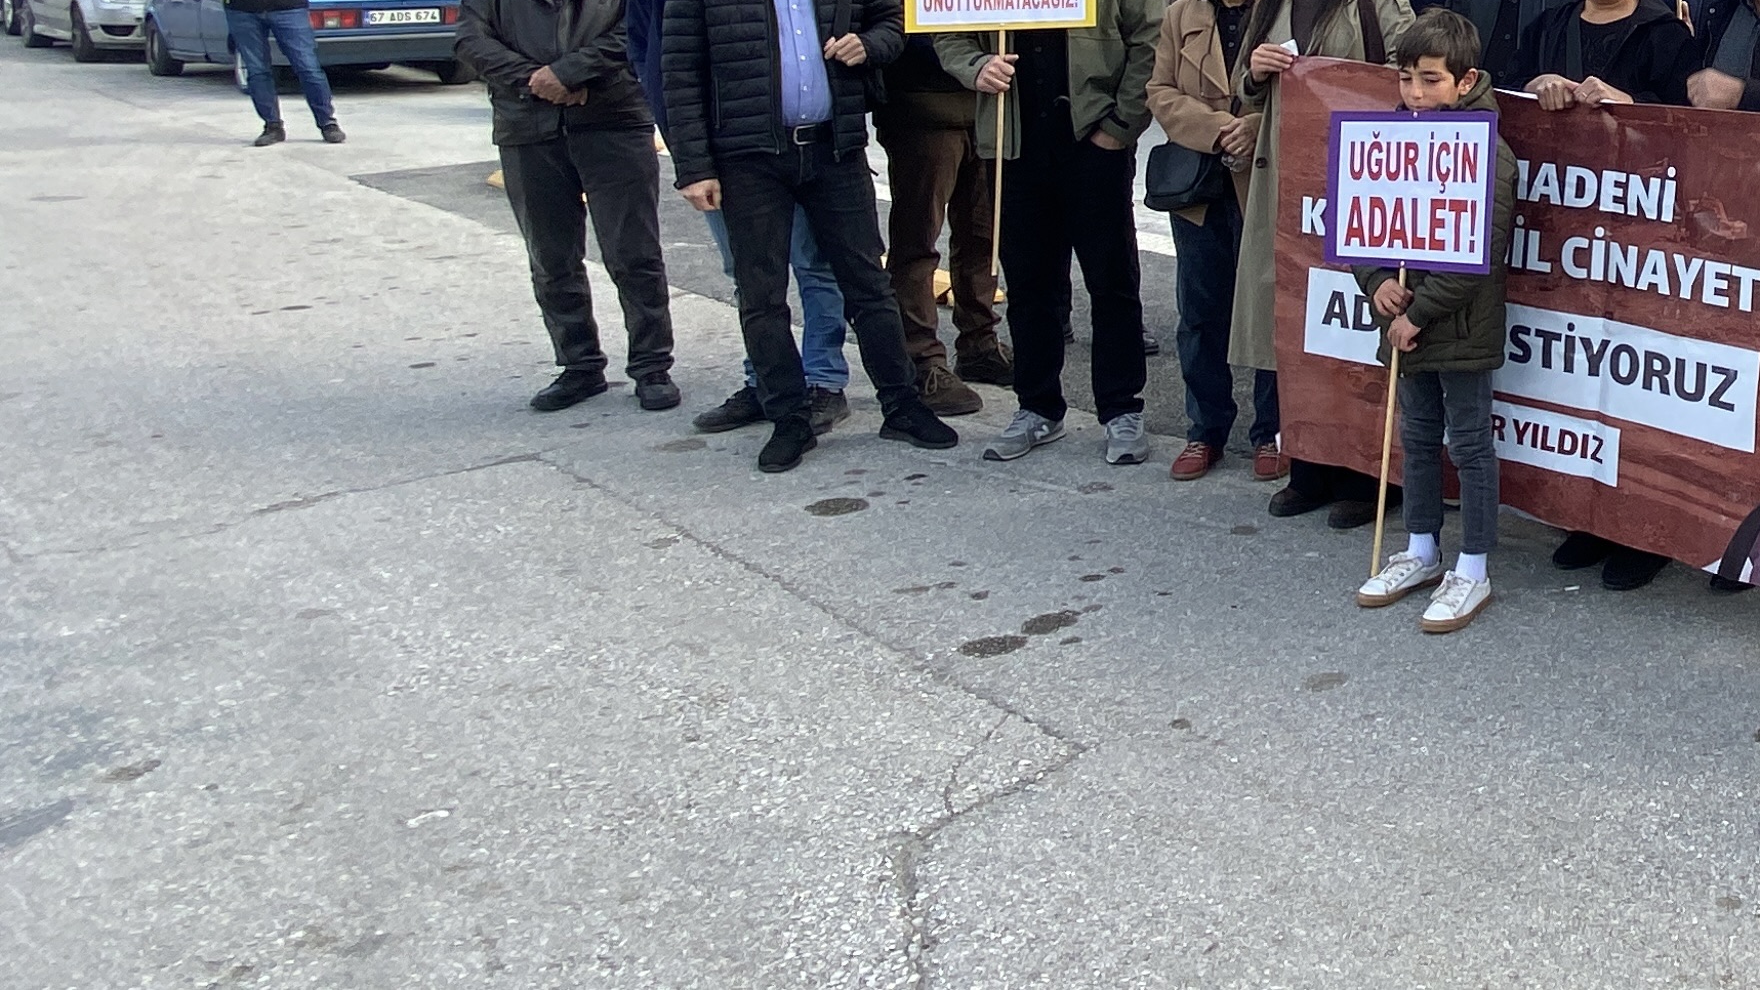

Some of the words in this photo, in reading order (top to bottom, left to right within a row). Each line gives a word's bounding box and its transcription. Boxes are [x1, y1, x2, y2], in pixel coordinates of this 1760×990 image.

[370, 13, 384, 22] 67
[390, 12, 411, 21] ADS
[415, 11, 437, 20] 674
[1350, 130, 1420, 182] UĞUR
[1427, 131, 1479, 193] İÇİN
[1344, 196, 1478, 253] ADALET!
[1508, 322, 1738, 412] STİYORUZ
[1512, 419, 1604, 465] YILDIZ
